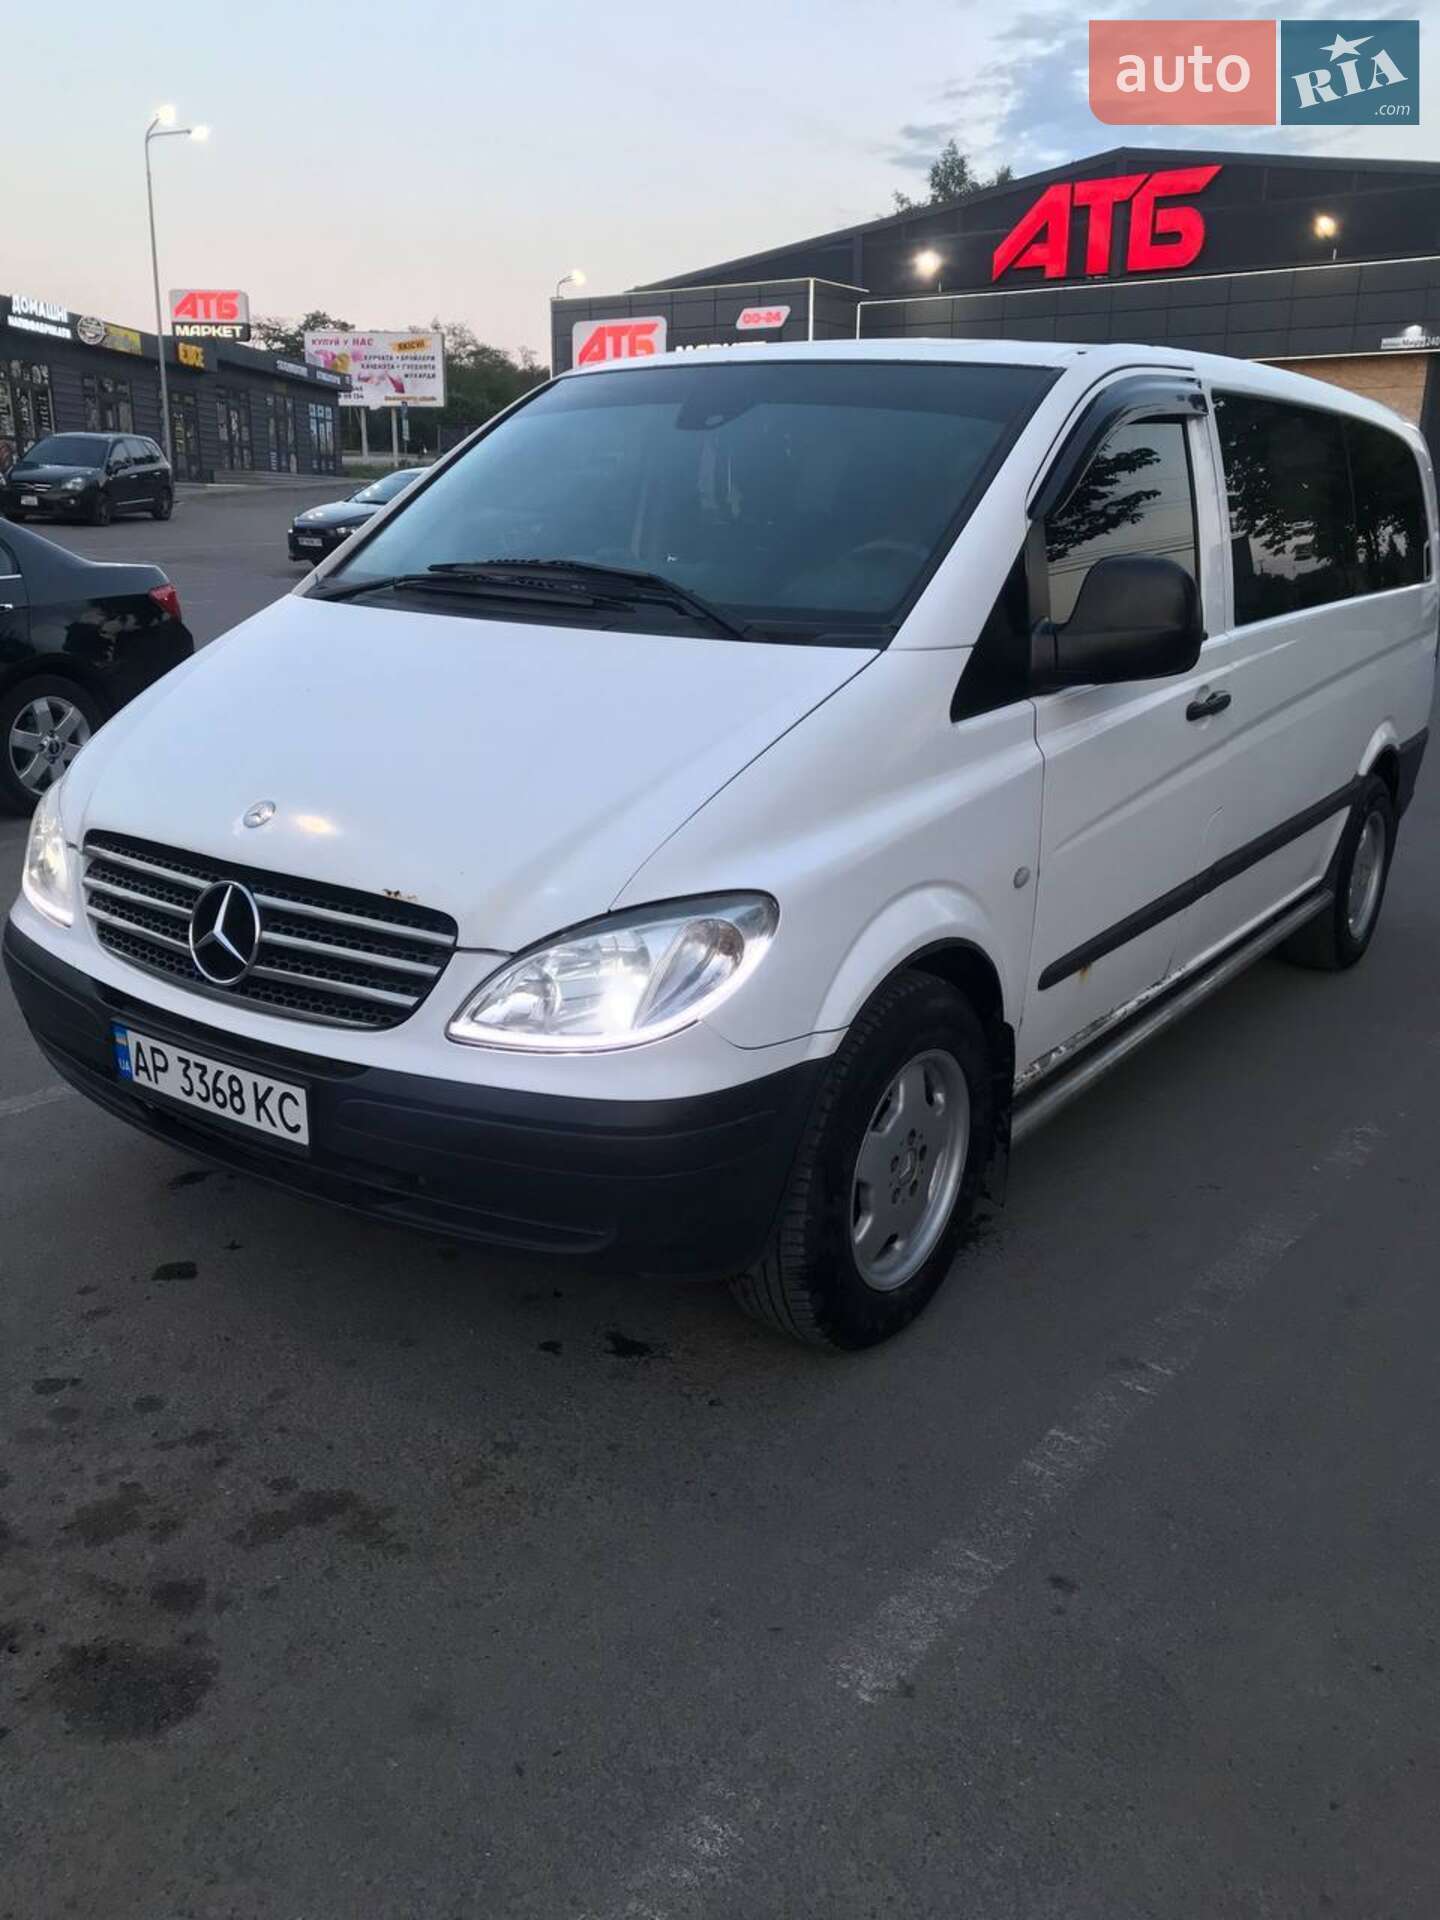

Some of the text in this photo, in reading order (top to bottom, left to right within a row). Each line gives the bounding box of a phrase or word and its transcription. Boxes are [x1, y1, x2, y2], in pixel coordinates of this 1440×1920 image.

[992, 163, 1223, 283] АТБ
[173, 290, 240, 320] АТБ
[175, 325, 243, 338] МАРКЕТ
[353, 338, 374, 346] НАС
[578, 322, 659, 366] АТБ
[134, 1040, 302, 1134] AP 3368 KC
